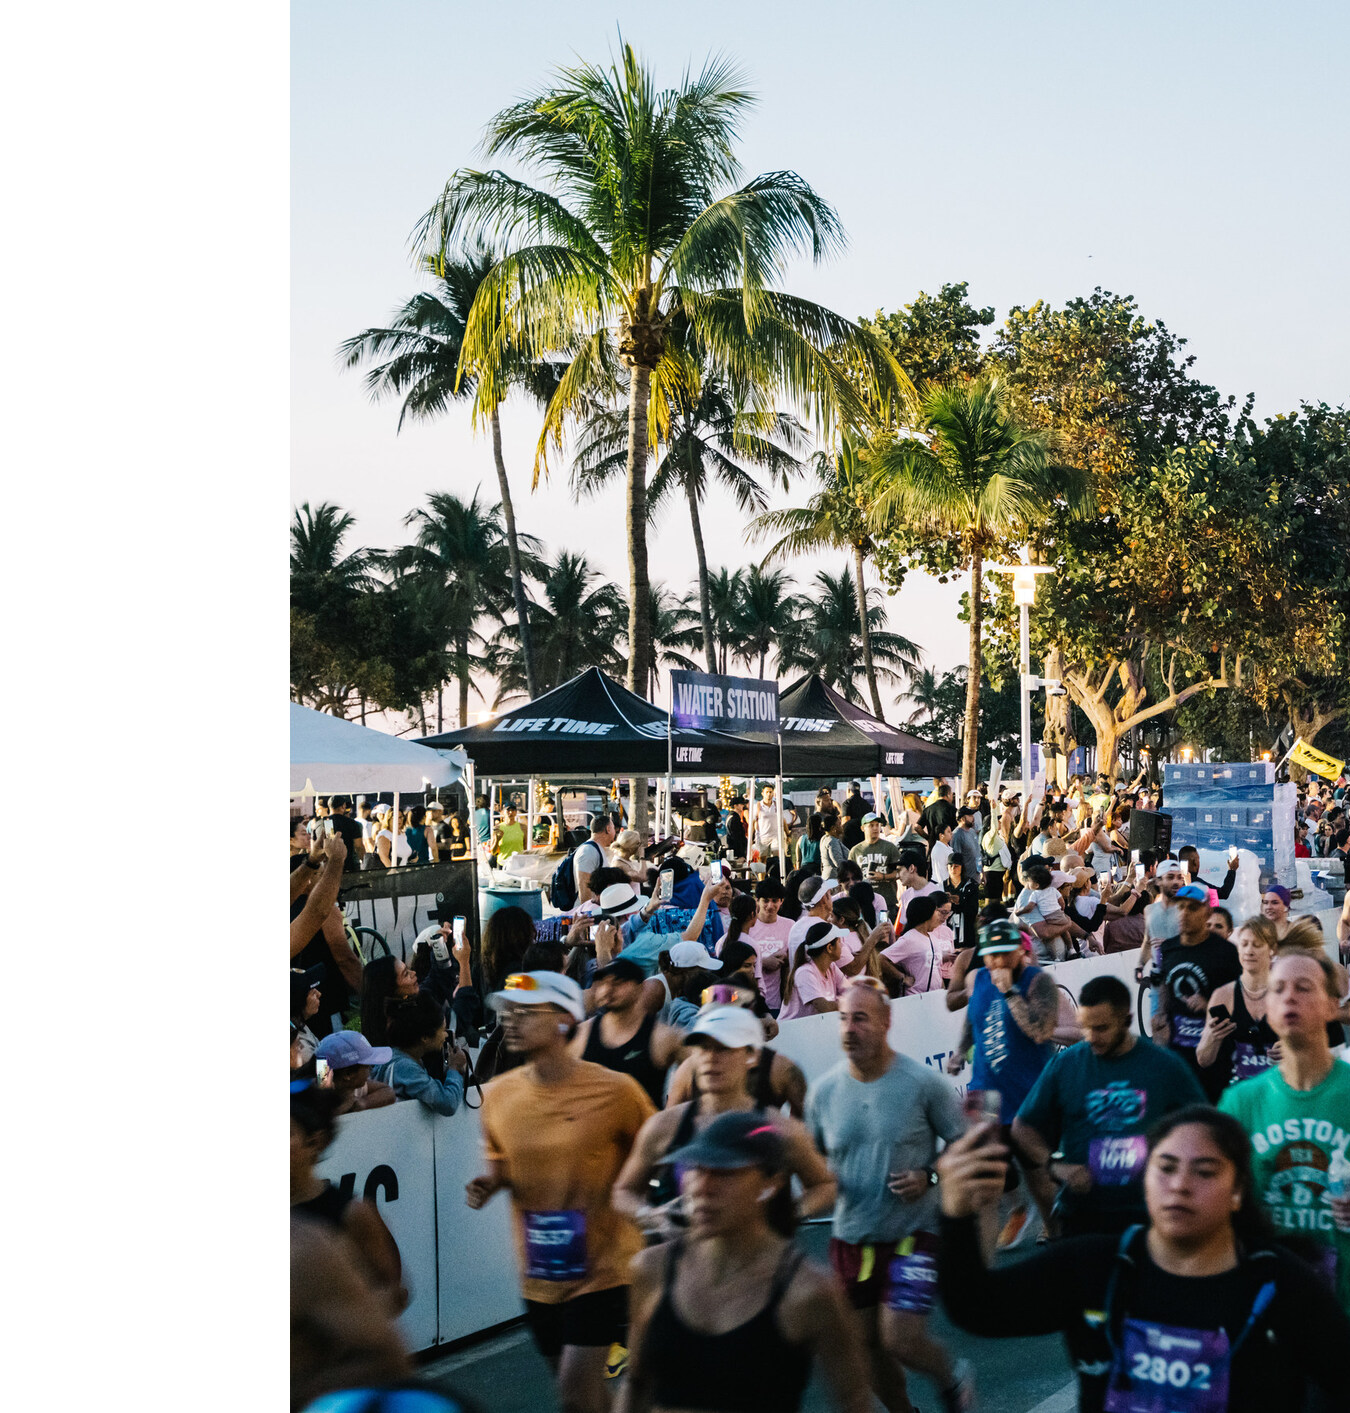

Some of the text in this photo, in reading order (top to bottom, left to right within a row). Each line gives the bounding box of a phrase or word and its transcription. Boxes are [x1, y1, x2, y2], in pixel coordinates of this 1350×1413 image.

[678, 683, 776, 721] WATER STATION
[493, 718, 615, 735] LIFE TIME
[784, 717, 836, 733] TIME
[676, 747, 704, 762] LIFE TIME
[1272, 1206, 1334, 1230] ELTIC
[1133, 1353, 1211, 1390] 2802
